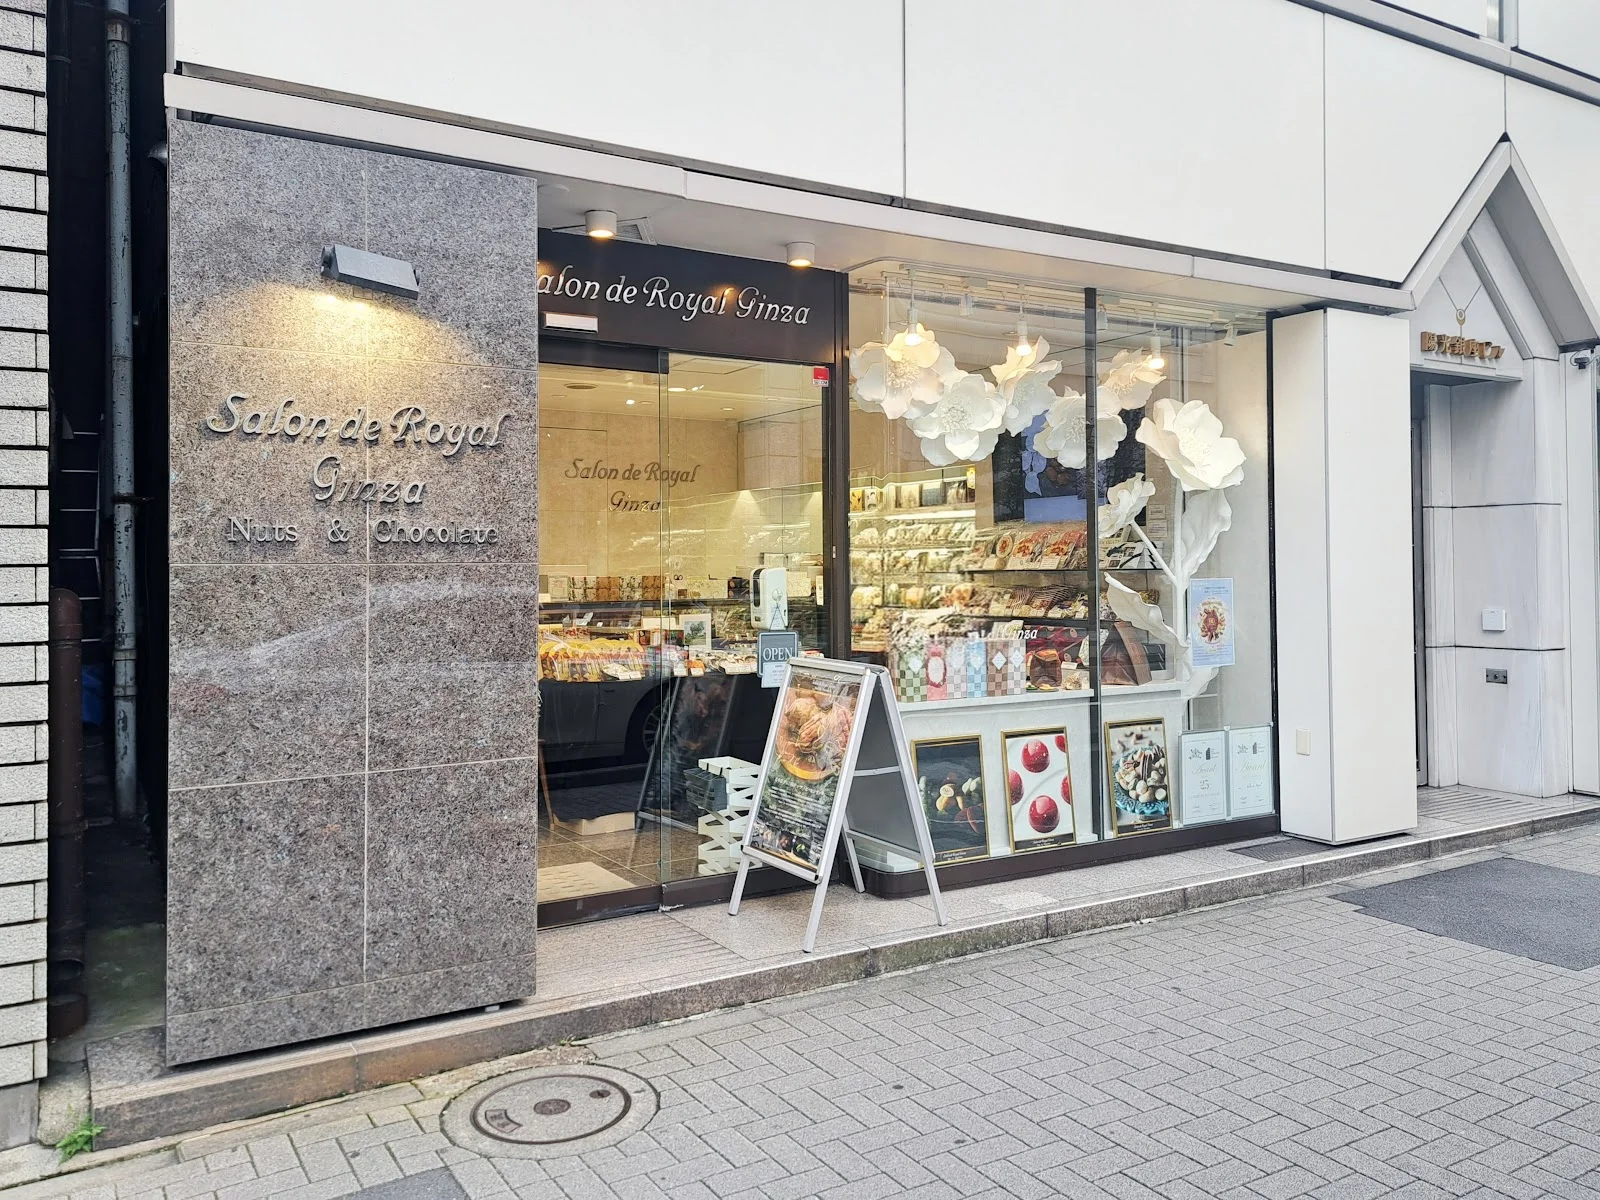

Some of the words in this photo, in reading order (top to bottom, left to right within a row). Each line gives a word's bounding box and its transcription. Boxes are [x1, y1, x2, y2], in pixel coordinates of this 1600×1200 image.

[537, 264, 600, 299] alon
[605, 275, 638, 304] de
[643, 276, 734, 322] Royal
[735, 286, 811, 325] Ginza
[205, 393, 331, 439] Salon
[339, 407, 382, 442] de
[390, 405, 511, 457] Royal
[312, 455, 426, 504] Ginza
[564, 458, 618, 480] Salon
[621, 463, 641, 481] de
[644, 461, 701, 488] Royal
[609, 490, 661, 513] Ginza
[228, 516, 299, 543] Nuts
[327, 518, 350, 544] &
[373, 518, 499, 545] Chocolate
[762, 646, 793, 661] OPEN
